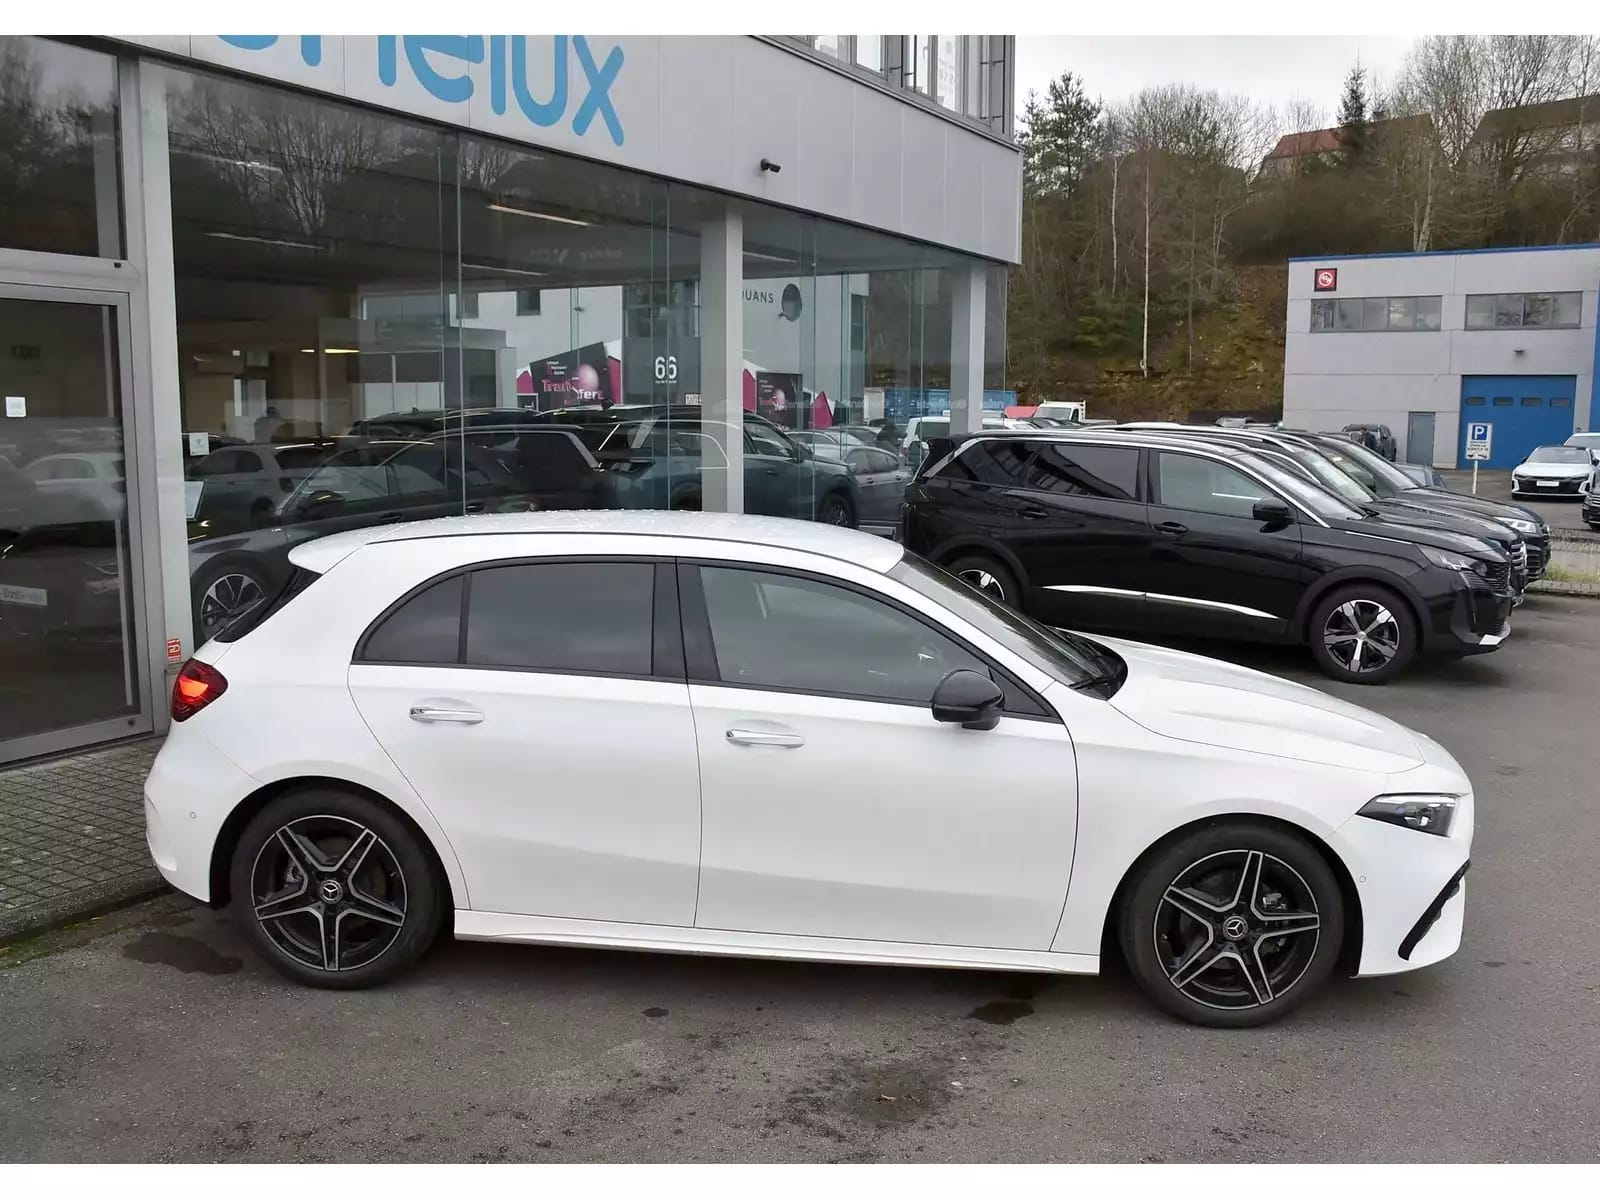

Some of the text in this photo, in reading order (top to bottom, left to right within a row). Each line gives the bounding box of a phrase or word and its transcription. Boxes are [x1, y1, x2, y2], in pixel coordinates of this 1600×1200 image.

[742, 289, 774, 303] UANS
[655, 355, 677, 379] 66
[1474, 426, 1485, 440] P
